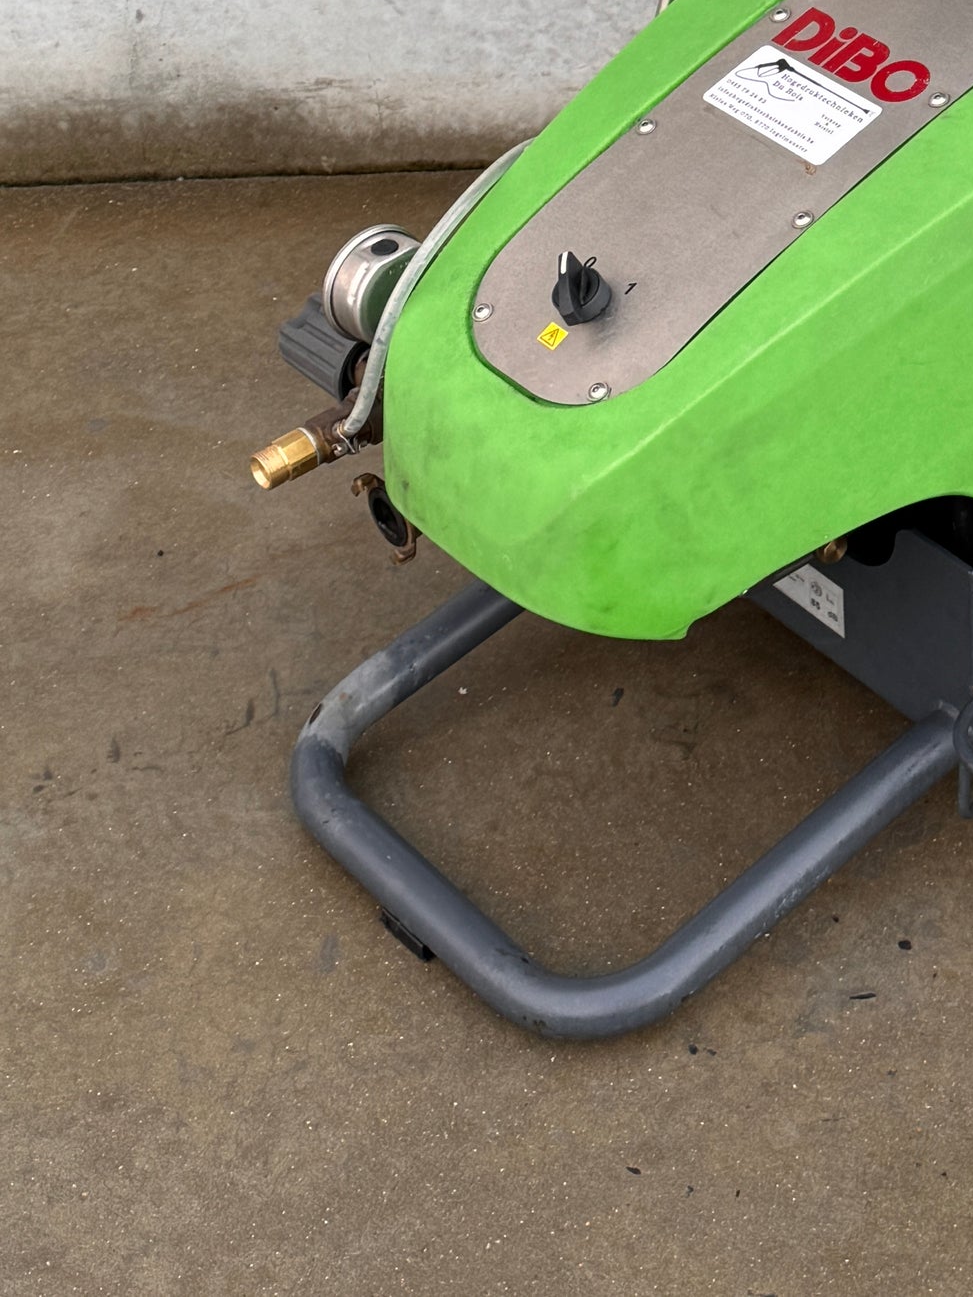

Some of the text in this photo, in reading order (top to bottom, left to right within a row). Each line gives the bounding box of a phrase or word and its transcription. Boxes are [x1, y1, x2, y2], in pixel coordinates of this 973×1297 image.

[771, 6, 931, 103] DiBO
[772, 80, 785, 90] Du
[624, 282, 637, 295] 1
